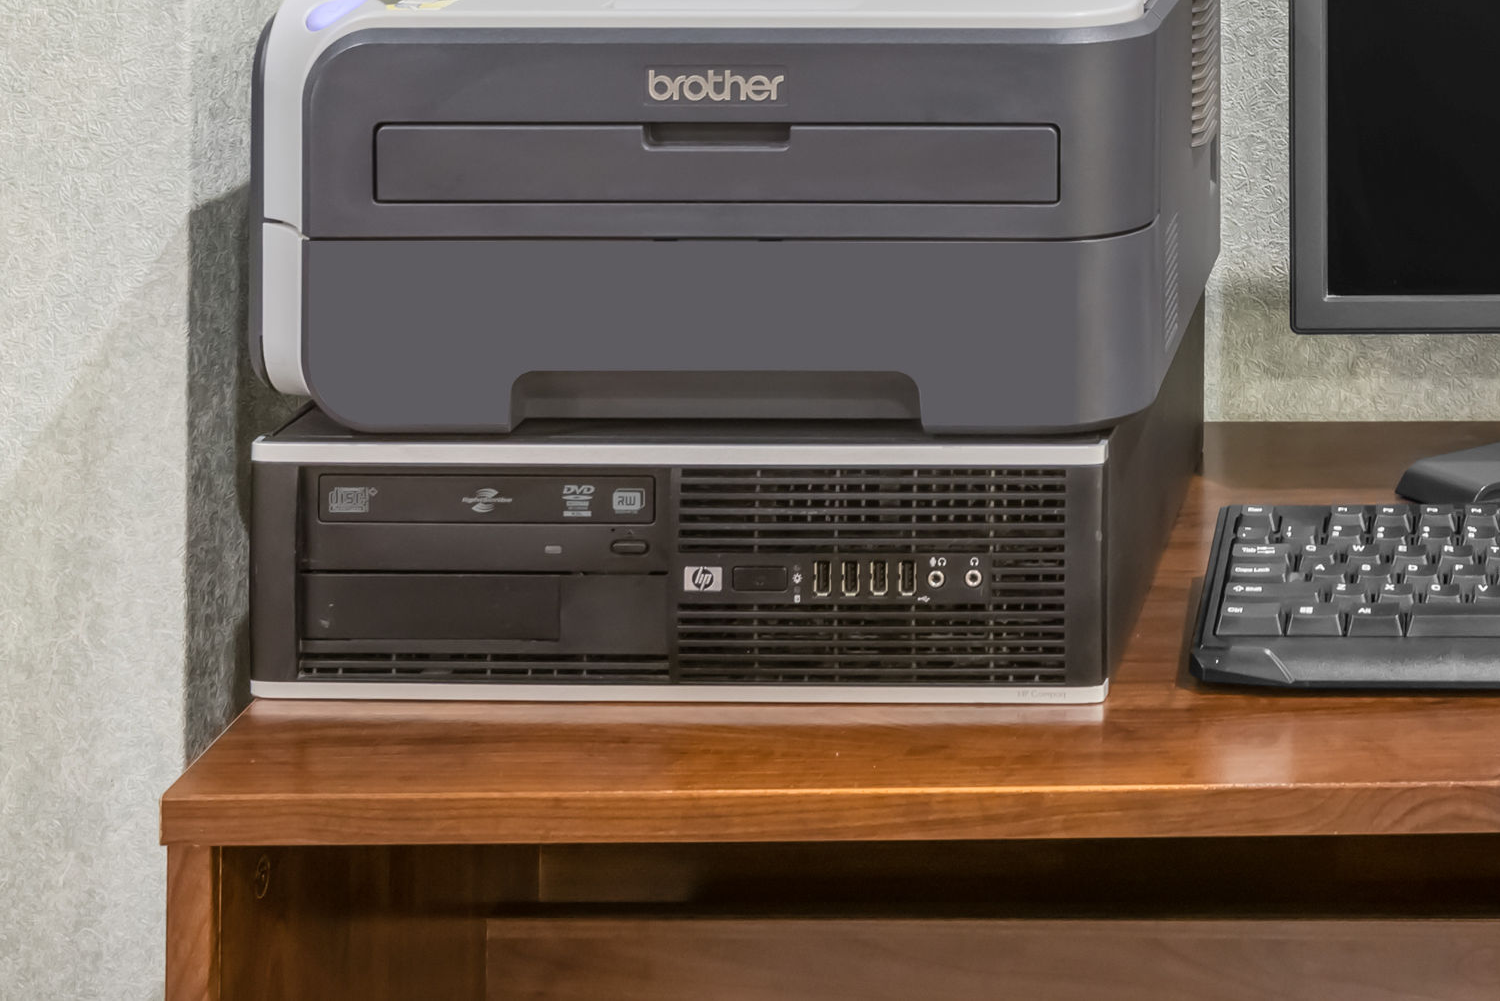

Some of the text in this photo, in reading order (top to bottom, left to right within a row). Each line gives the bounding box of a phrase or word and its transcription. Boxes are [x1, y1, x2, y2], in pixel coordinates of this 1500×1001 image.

[648, 69, 785, 101] brother
[562, 484, 596, 495] DVD
[616, 495, 637, 507] RW
